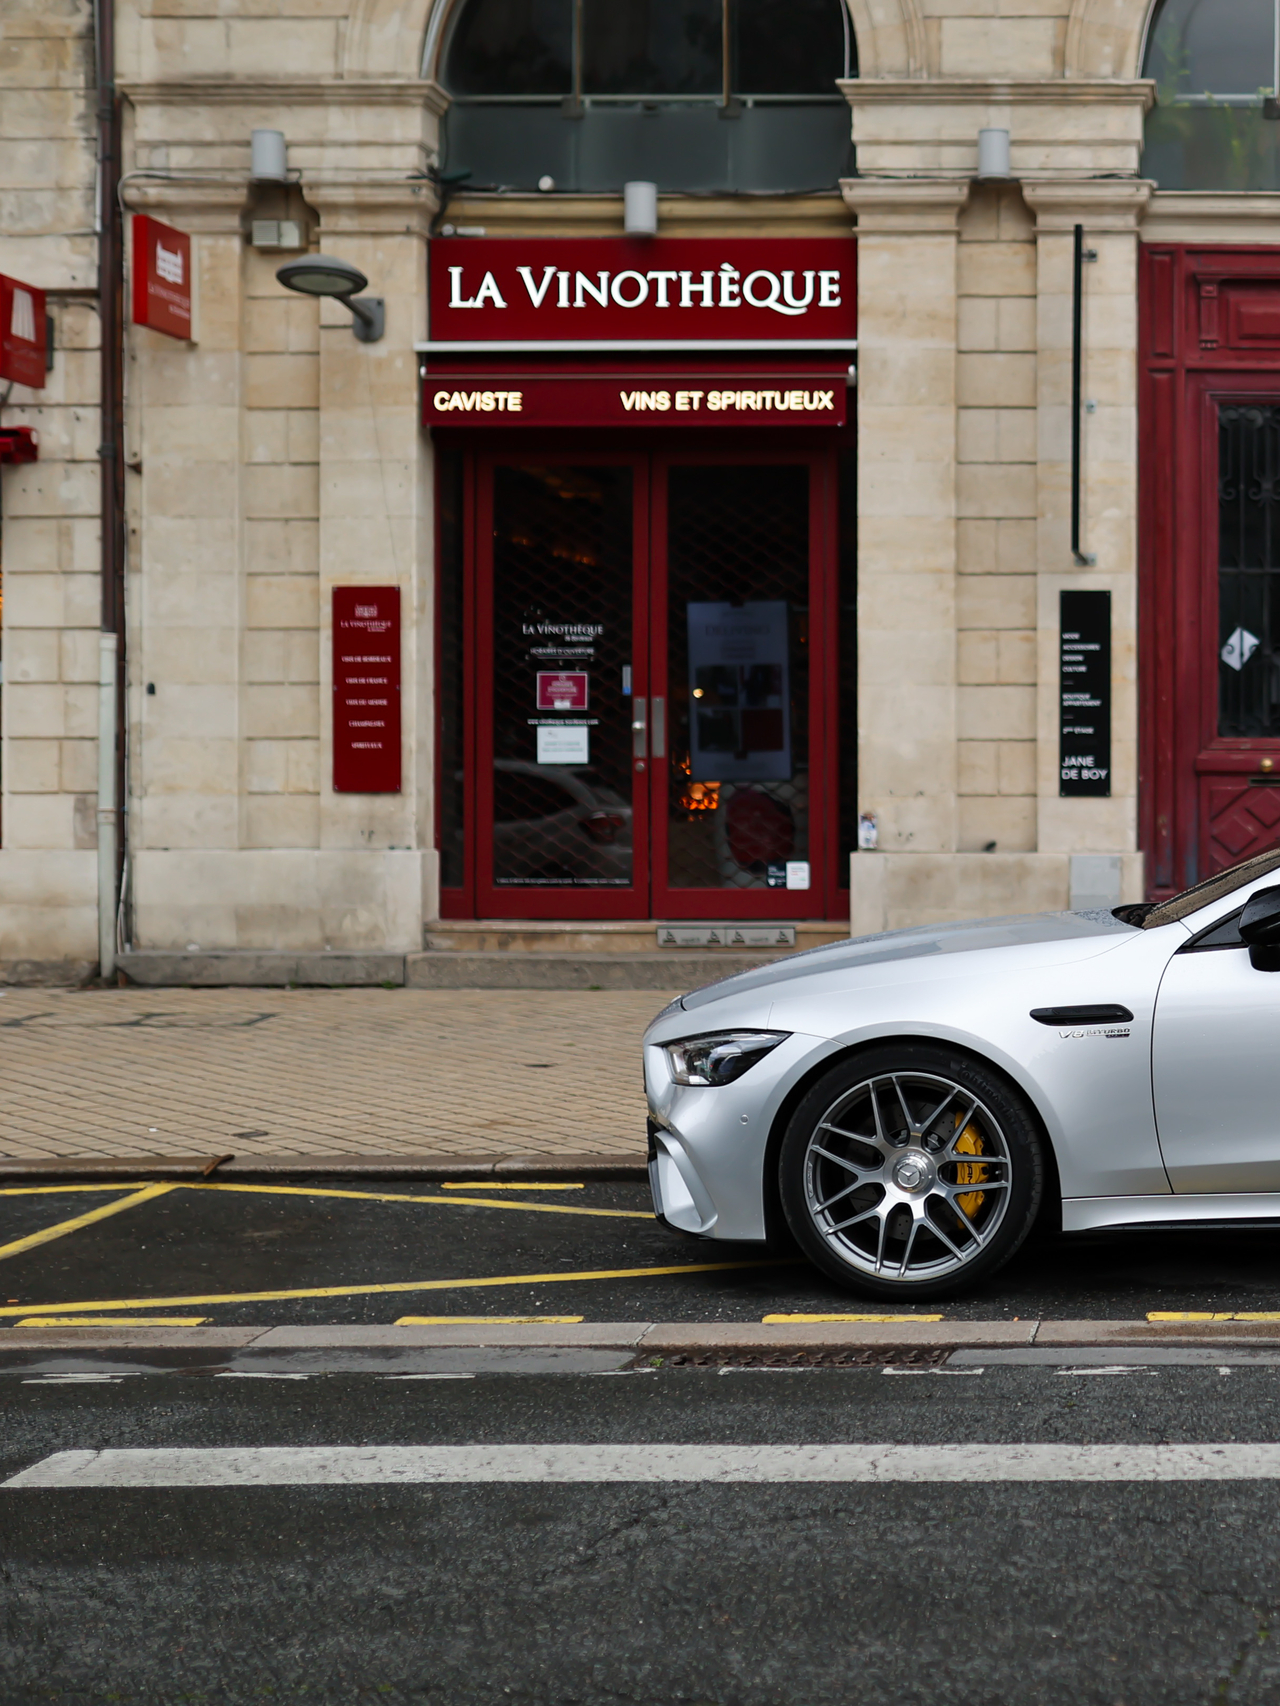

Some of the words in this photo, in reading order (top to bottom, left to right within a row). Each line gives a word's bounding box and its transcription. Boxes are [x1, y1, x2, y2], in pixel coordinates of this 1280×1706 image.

[448, 266, 508, 308] LA
[516, 262, 842, 316] VINOTHÈQUE
[433, 391, 523, 411] CAVISTE
[620, 391, 671, 411] VINS
[675, 391, 703, 411] ET
[706, 391, 834, 412] SPIRITUEUX
[1062, 756, 1095, 767] JANE
[1062, 768, 1079, 780] DE
[1081, 768, 1108, 780] BOY
[1059, 1030, 1084, 1039] V8
